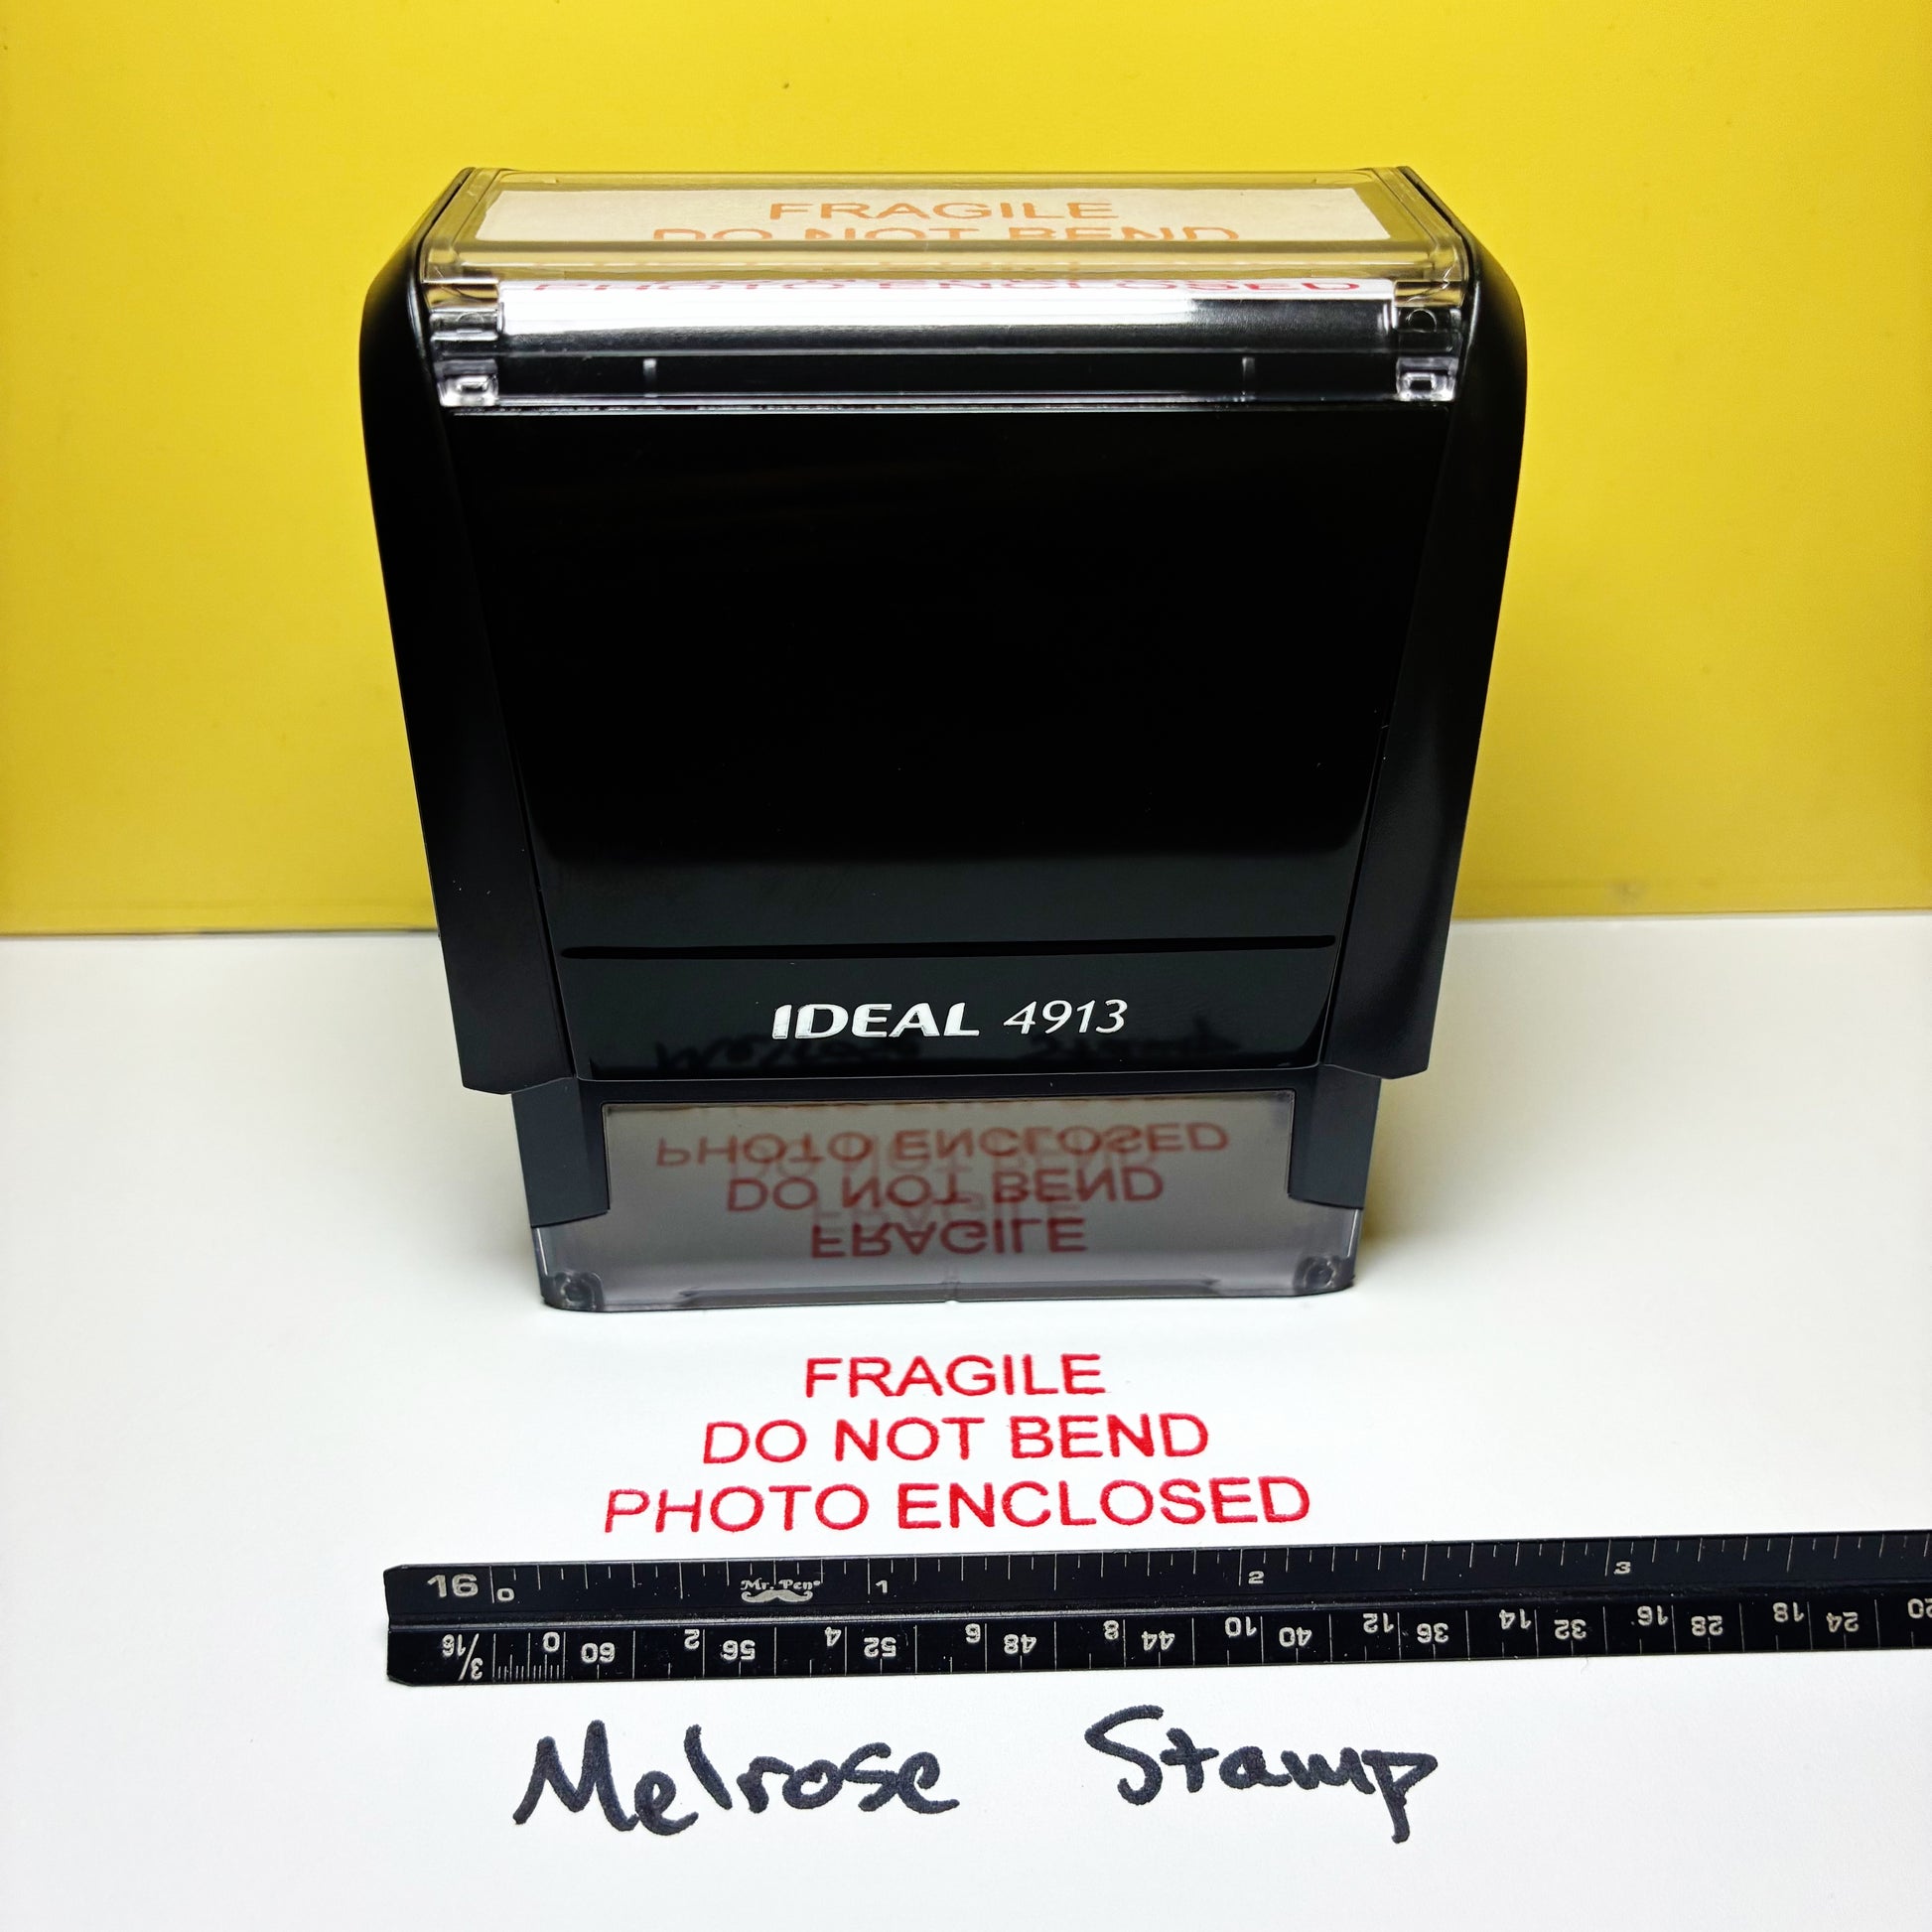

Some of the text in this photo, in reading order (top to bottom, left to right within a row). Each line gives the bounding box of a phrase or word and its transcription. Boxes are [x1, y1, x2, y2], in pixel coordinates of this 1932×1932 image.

[769, 202, 1119, 220] FRAGILE
[771, 999, 1128, 1040] IDEAL 4913
[804, 1353, 1107, 1399] FRAGILE
[703, 1412, 1209, 1464] DO NOT BEND
[604, 1475, 1311, 1534] PHOTO ENCLOSED
[427, 1574, 479, 1598] 16
[875, 1580, 888, 1593] 1
[1248, 1570, 1265, 1585] 2
[1613, 1561, 1631, 1575] 3
[740, 1577, 774, 1590] Mr.
[1362, 1612, 1395, 1634] 12
[1498, 1608, 1532, 1630] 14
[1637, 1604, 1669, 1626] 16
[1772, 1601, 1805, 1623] 18
[1826, 1611, 1859, 1633] 24
[824, 1626, 842, 1647] 4
[1103, 1619, 1120, 1640] 8
[1224, 1615, 1257, 1638] 10
[1279, 1626, 1312, 1648] 40
[1416, 1622, 1449, 1644] 36
[1554, 1618, 1587, 1640] 32
[1691, 1615, 1724, 1637] 28
[684, 1628, 701, 1650] 2
[720, 1639, 756, 1661] 56
[863, 1636, 897, 1658] 52
[1003, 1633, 1037, 1655] 48
[1141, 1630, 1175, 1651] 44
[442, 1633, 483, 1681] 3/16
[581, 1642, 616, 1664] 60
[512, 1704, 1439, 1845] Melrose Stamp
